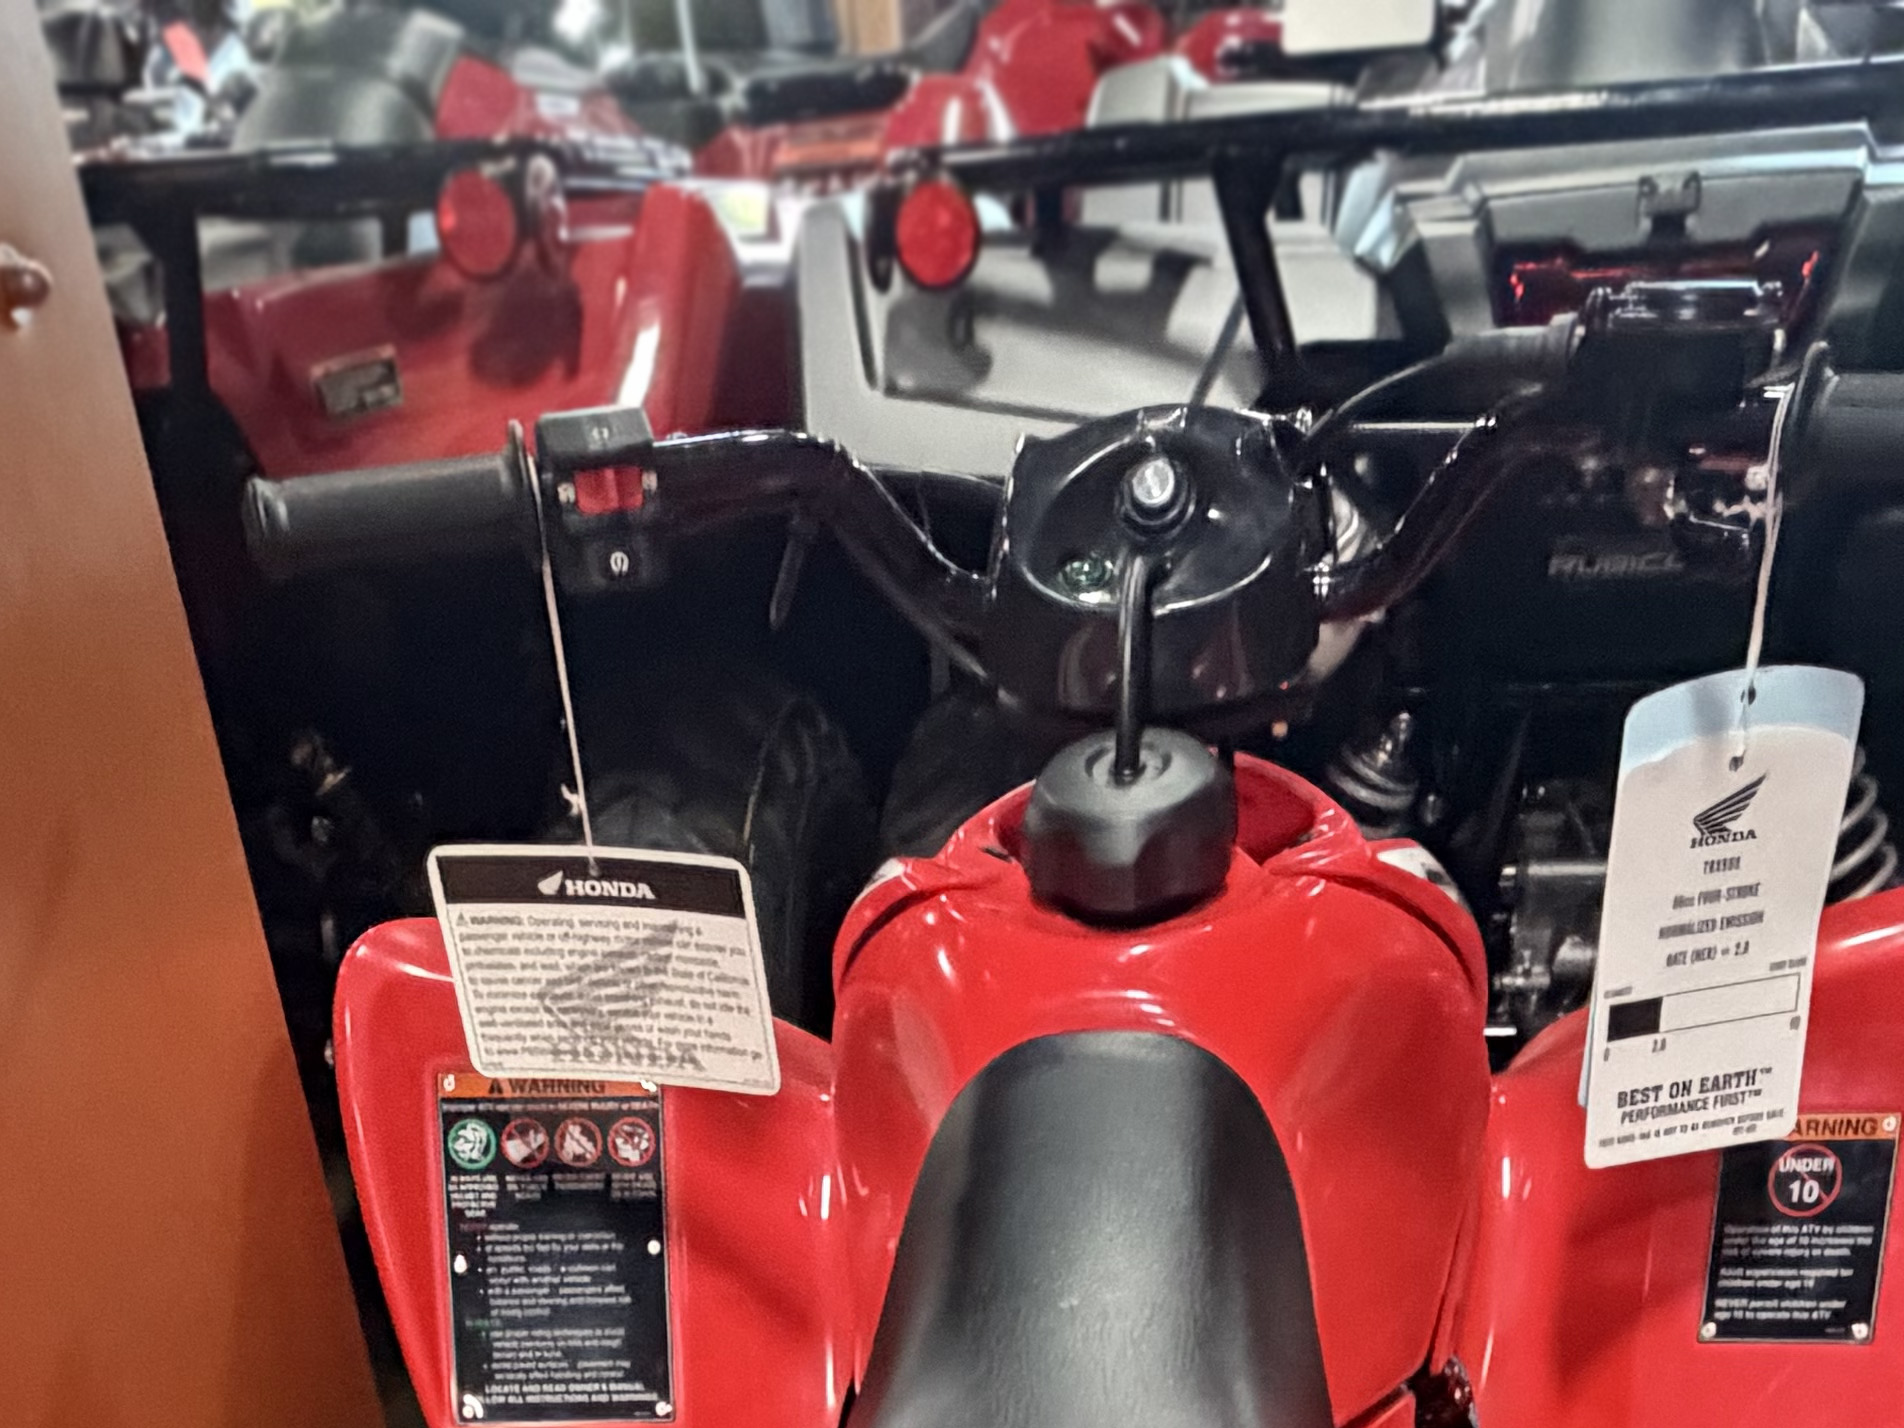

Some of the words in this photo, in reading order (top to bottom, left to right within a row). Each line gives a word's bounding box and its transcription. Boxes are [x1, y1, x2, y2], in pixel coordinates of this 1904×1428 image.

[1690, 829, 1757, 849] HONDA
[565, 880, 656, 899] HONDA
[510, 1078, 605, 1093] WARNING
[1617, 1085, 1663, 1108] BEST
[1669, 1080, 1692, 1098] ON
[1621, 1097, 1708, 1124] PERFORMANCE
[1793, 1117, 1878, 1137] ARNING
[1779, 1157, 1835, 1173] UNDER
[1789, 1179, 1820, 1203] 10
